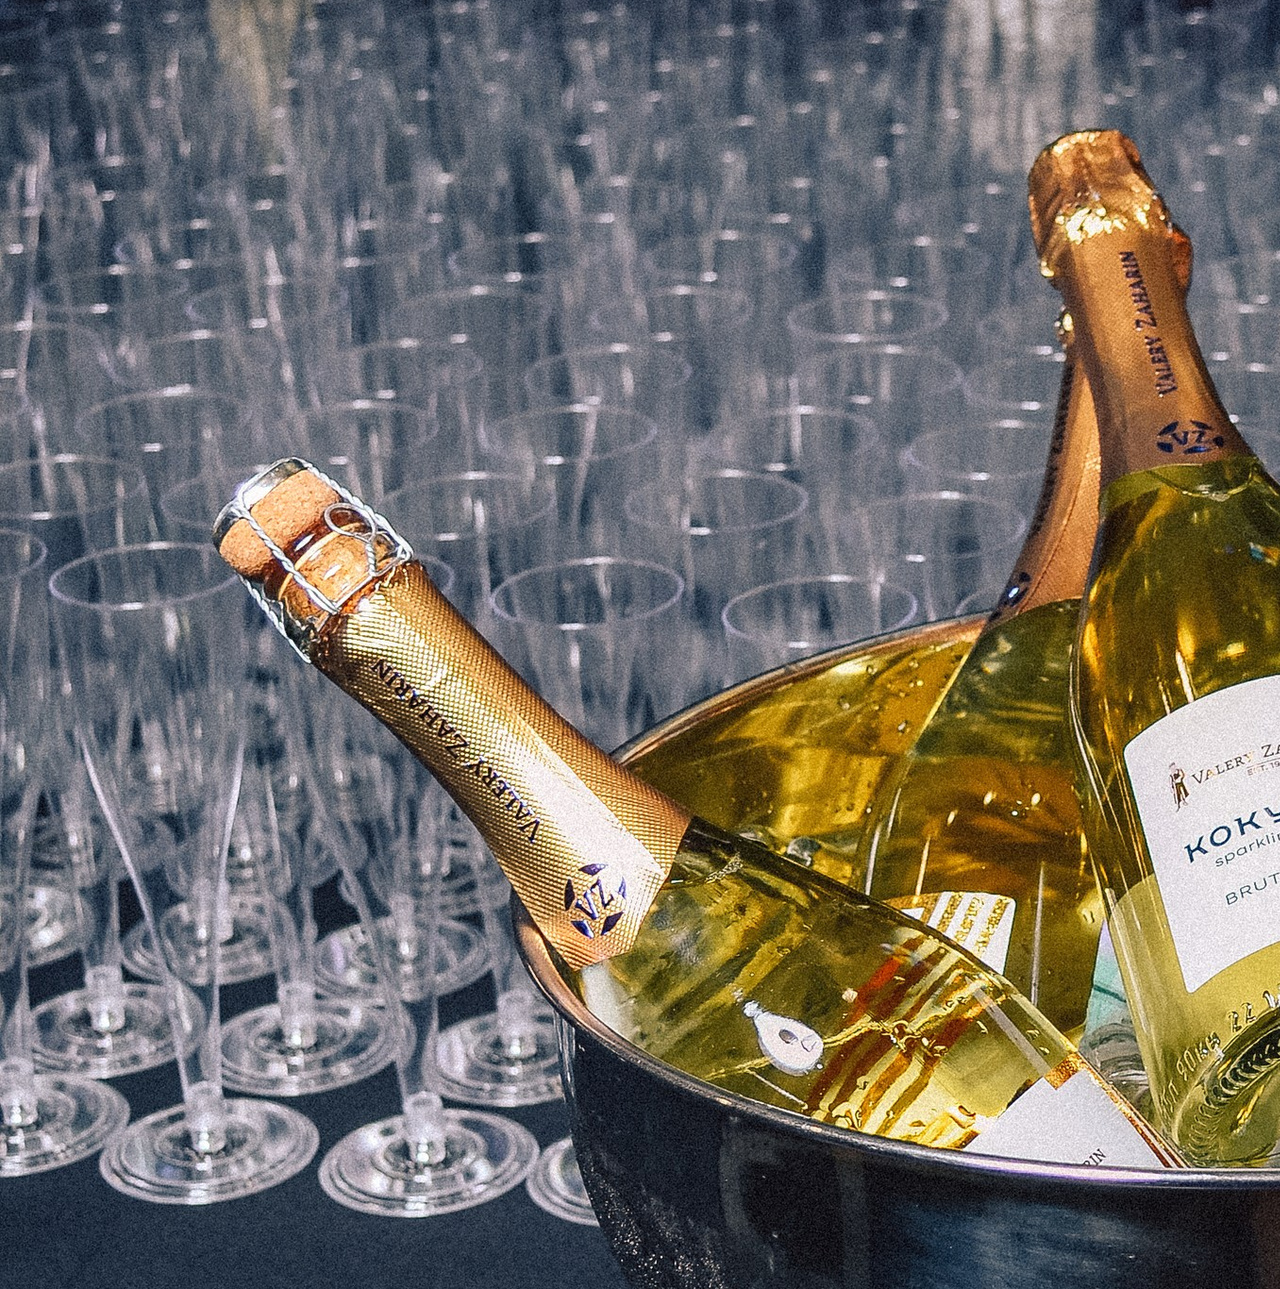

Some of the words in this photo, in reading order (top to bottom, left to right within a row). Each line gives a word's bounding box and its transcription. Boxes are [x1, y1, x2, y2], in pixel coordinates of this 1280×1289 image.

[1119, 251, 1157, 330] ZAHARIN
[1144, 335, 1178, 397] VALERY
[371, 658, 468, 759] ZAHARIN
[466, 754, 542, 844] VALERY
[1192, 752, 1254, 784] VALERY
[1226, 872, 1280, 905] BRUT
